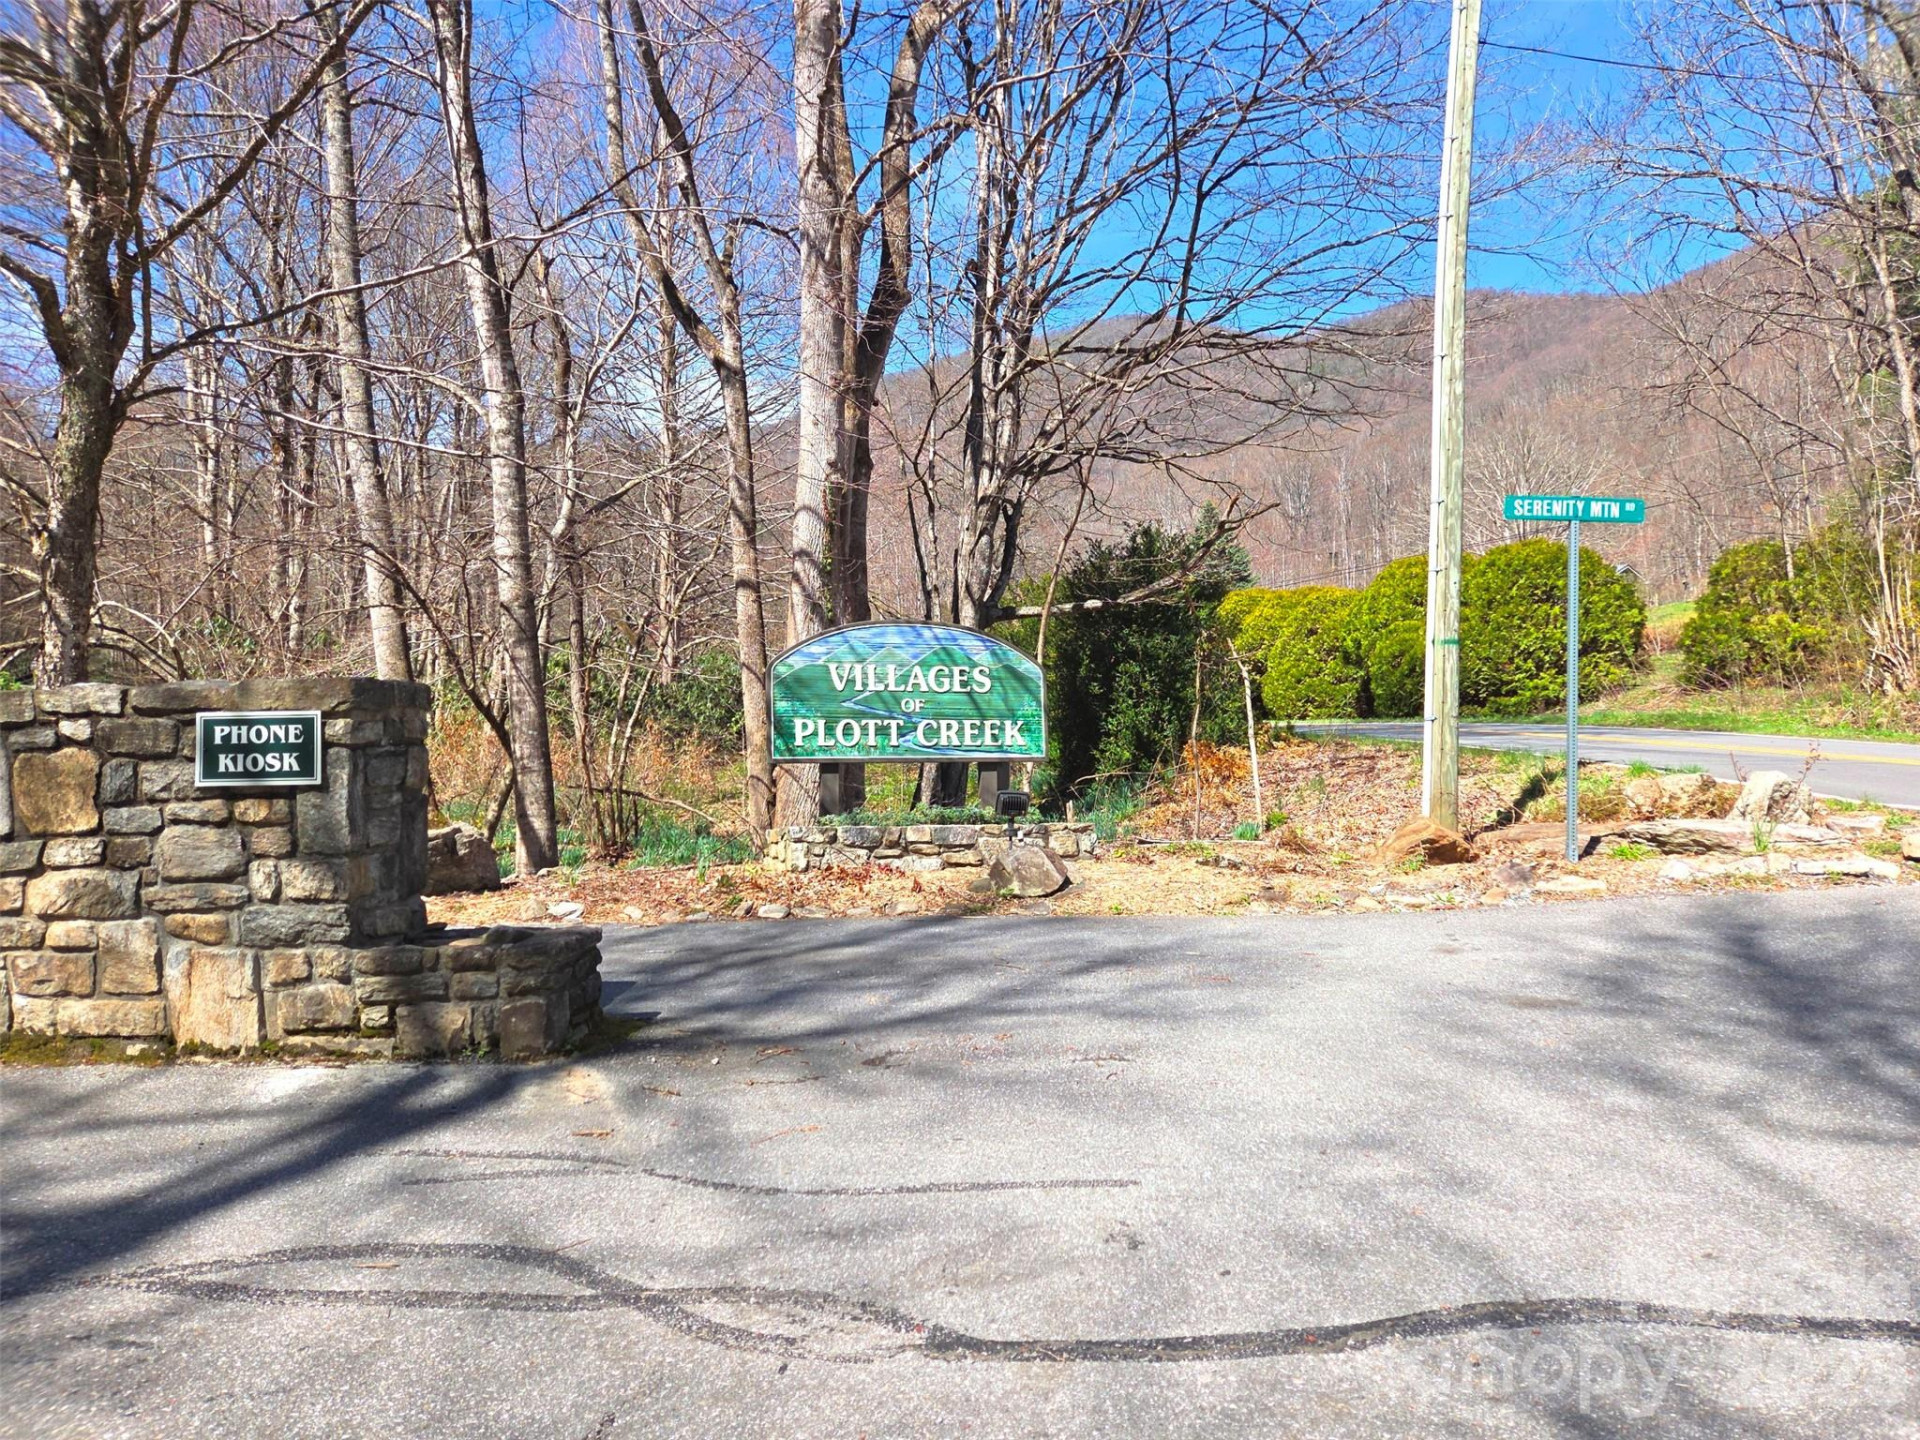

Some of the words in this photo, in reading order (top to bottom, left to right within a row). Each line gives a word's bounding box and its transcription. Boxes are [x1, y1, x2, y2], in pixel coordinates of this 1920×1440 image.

[1513, 499, 1585, 517] SERENITY
[1589, 501, 1620, 518] MTN
[1624, 502, 1636, 512] RD
[827, 662, 992, 694] VILLAGES
[900, 697, 926, 713] OF
[213, 724, 304, 745] PHONE
[793, 718, 904, 747] PLOTT
[915, 718, 1026, 748] CREEK
[218, 752, 301, 773] KIOSK
